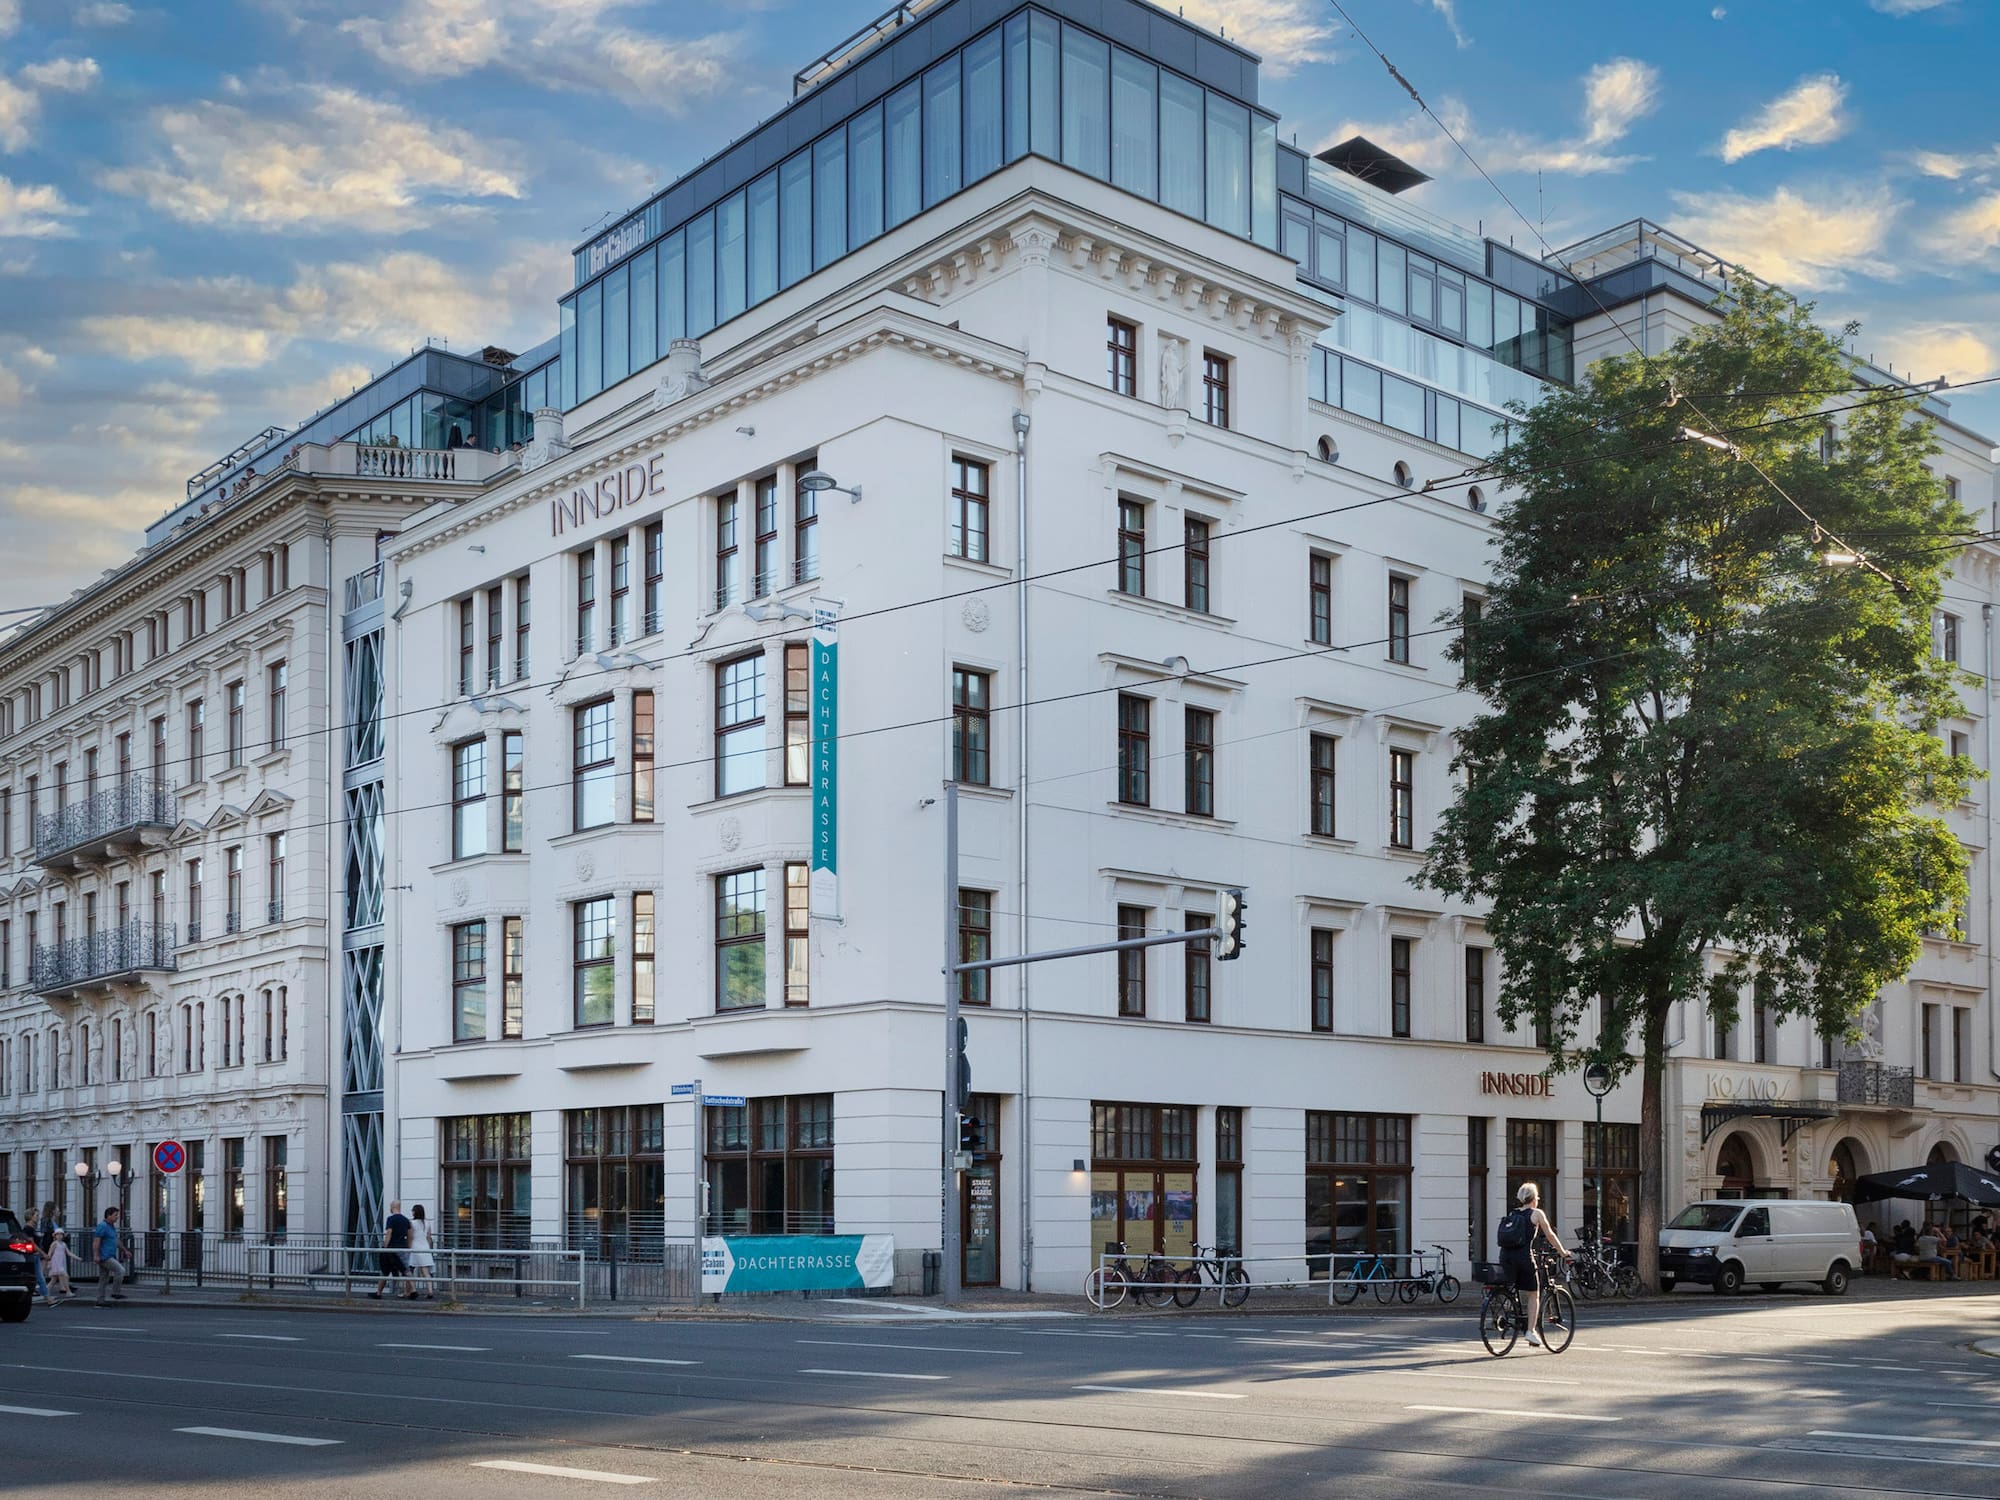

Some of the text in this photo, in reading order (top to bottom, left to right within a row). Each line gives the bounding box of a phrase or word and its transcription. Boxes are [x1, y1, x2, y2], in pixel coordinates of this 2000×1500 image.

[551, 452, 665, 537] INNSIDE
[821, 652, 830, 861] DACHTERRASSE
[1482, 1072, 1555, 1097] INNSIDE
[1706, 1073, 1791, 1100] KOSMOS
[738, 1255, 851, 1270] DACHTERRASSE
